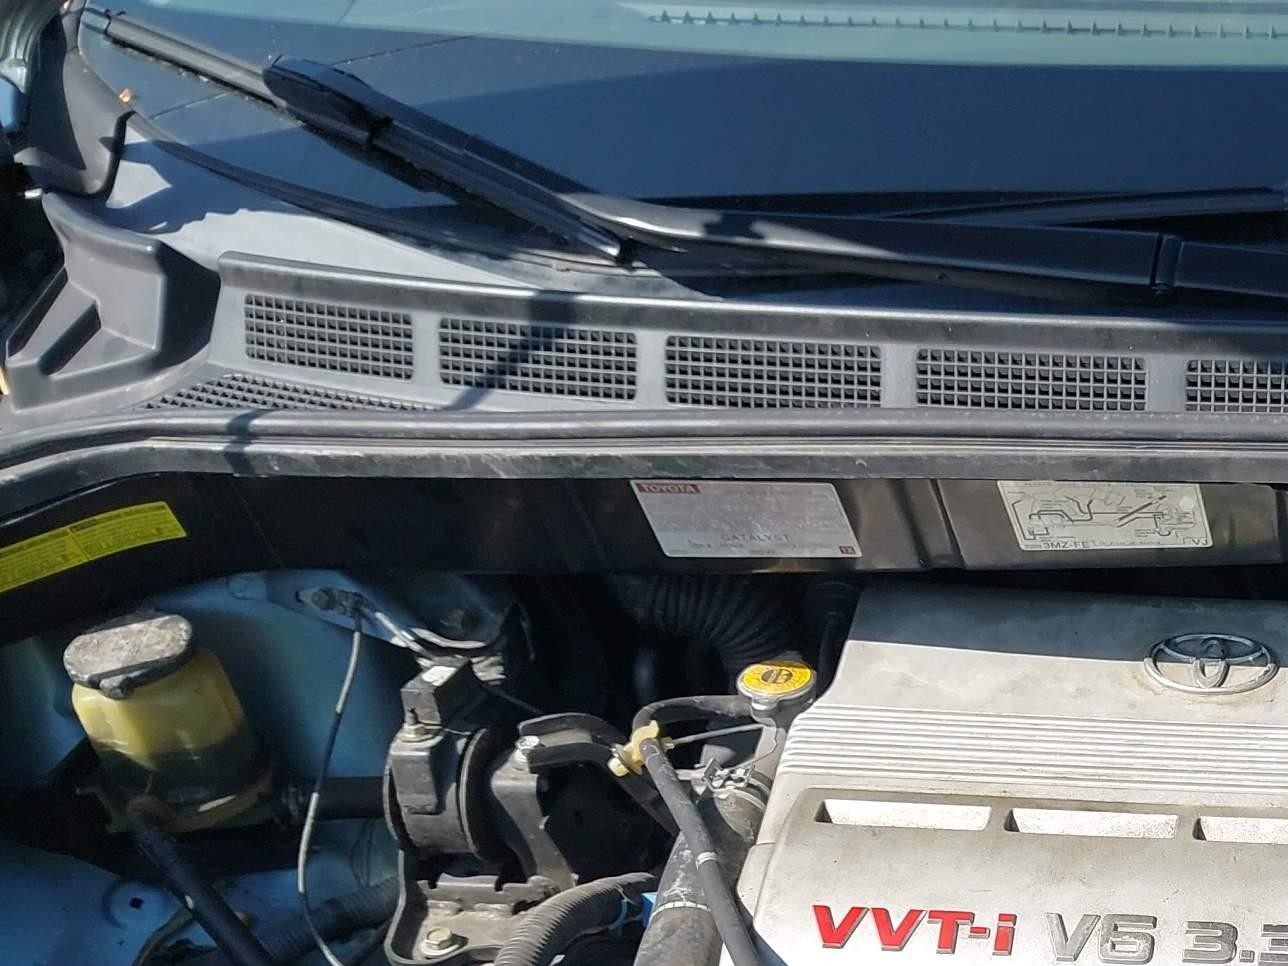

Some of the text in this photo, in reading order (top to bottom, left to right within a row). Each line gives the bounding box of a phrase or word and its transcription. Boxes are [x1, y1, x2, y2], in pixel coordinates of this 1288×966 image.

[643, 485, 695, 493] TOYOTA
[812, 904, 1018, 956] VVT-i
[1046, 912, 1158, 965] V6
